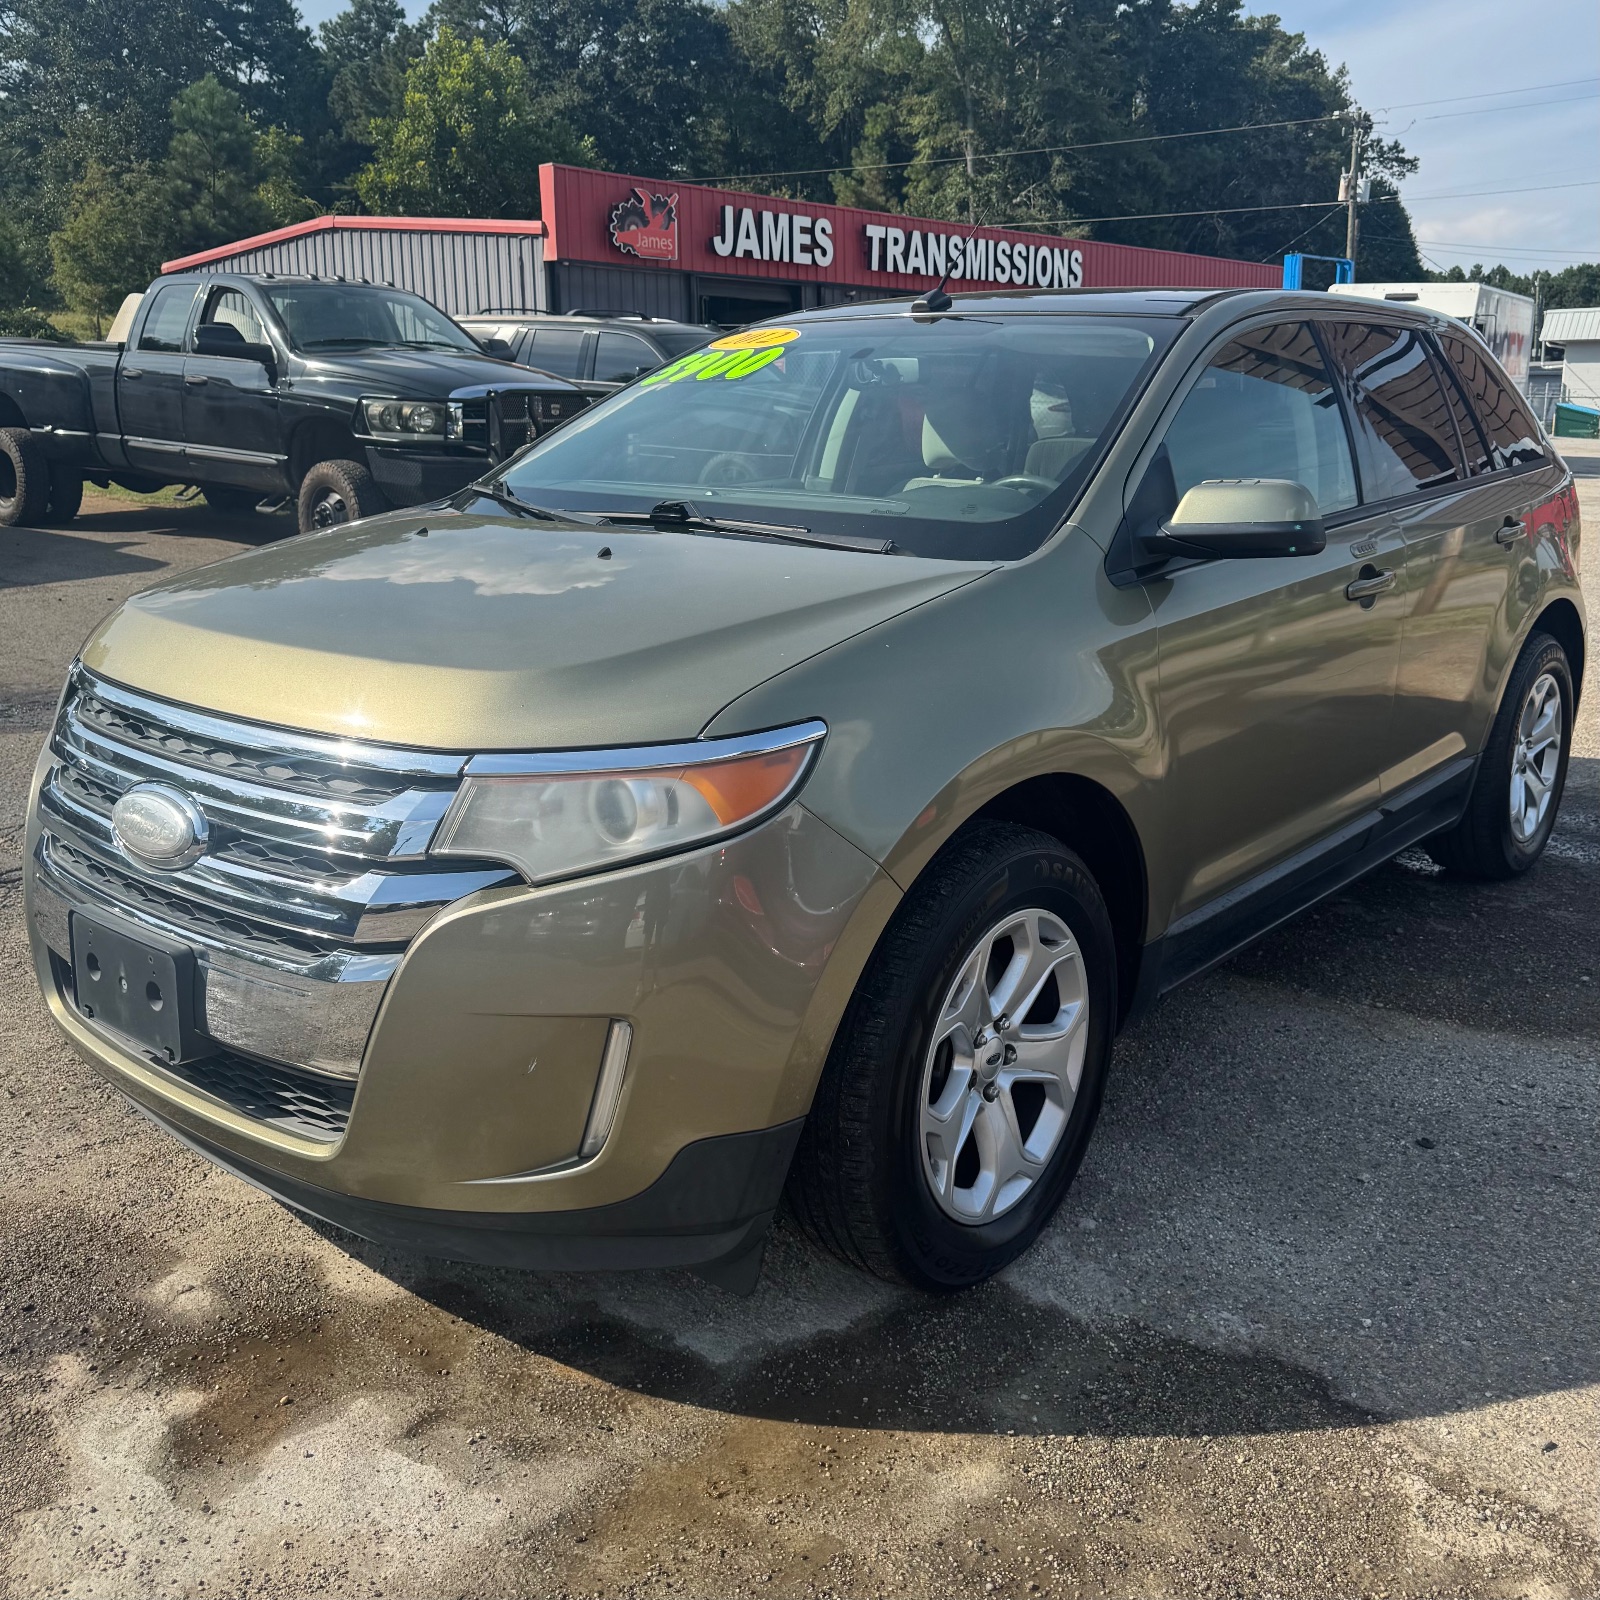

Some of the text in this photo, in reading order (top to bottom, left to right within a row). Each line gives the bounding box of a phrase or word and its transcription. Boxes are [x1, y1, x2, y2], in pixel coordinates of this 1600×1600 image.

[636, 231, 673, 251] James
[713, 204, 1083, 290] JAMES TRANSMISSIONS
[640, 347, 785, 387] 3900
